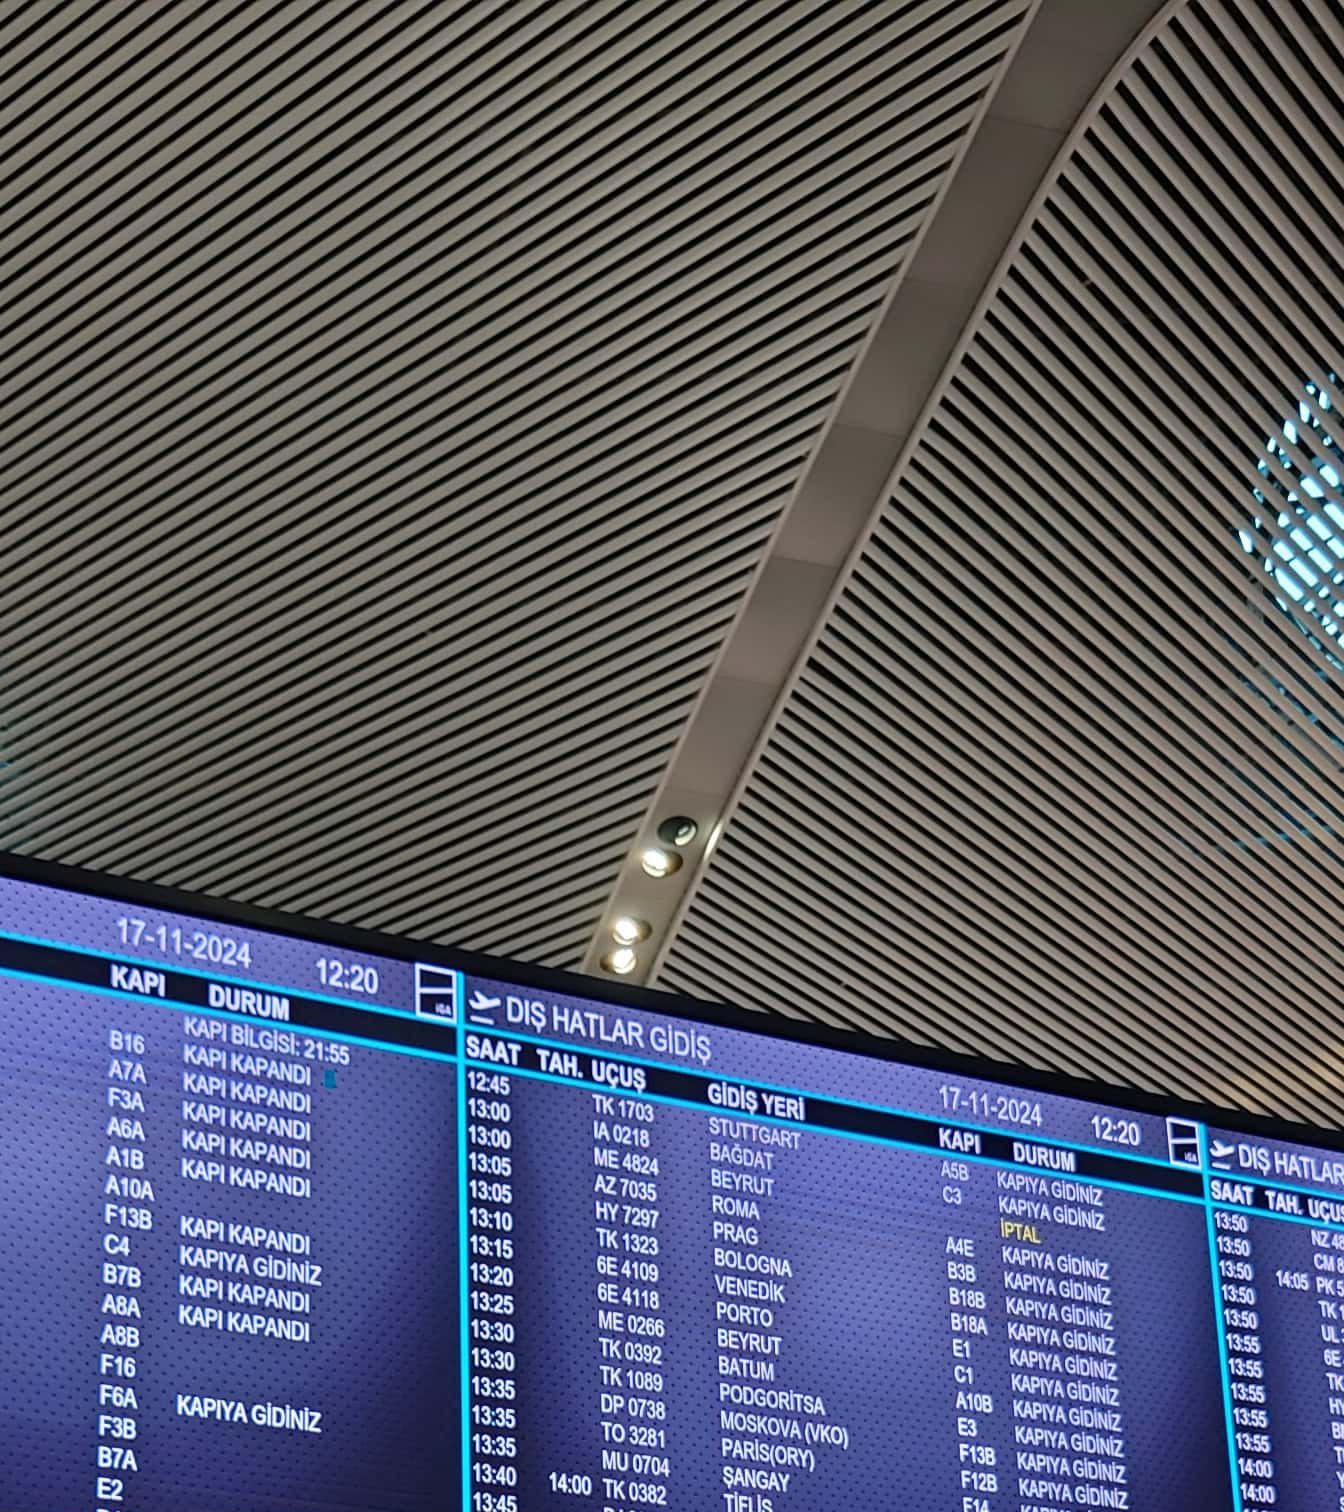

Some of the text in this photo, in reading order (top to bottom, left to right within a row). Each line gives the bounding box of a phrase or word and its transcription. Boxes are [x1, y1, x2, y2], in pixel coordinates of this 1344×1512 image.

[117, 917, 251, 968] 17-11-2024
[316, 958, 378, 994] 12:20
[111, 964, 165, 996] KAPI
[209, 983, 289, 1020] DURUM
[184, 1016, 226, 1041] KAPI
[231, 1023, 300, 1055] BİLGİSİ:
[303, 1038, 349, 1065] 21:55
[506, 995, 1140, 1146] DIŞ HATLAR GİDİŞ 17-11-2024 12:20
[108, 1086, 144, 1112] F3A
[182, 1100, 225, 1126] KAPI
[229, 1109, 310, 1141] KAPANDI
[466, 1034, 1075, 1172] SAAT TAH. UÇUŞ GİDİŞ YERİ KAPI DURUM
[468, 1124, 1041, 1243] 13:00 ME 4824 BEYRUT İPTAL
[1238, 1143, 1270, 1176] DIŞ
[1210, 1179, 1253, 1205] SAAT
[1264, 1189, 1302, 1214] TAH.
[1218, 1259, 1252, 1280] 13:50
[1275, 1269, 1309, 1290] 14:05
[99, 1383, 137, 1408] F6A
[177, 1394, 248, 1423] KAPIYA
[251, 1401, 321, 1433] GİDİNİZ
[471, 1375, 1126, 1484] 13:35 DP 0738 MOSKOVA (VKO) F13B KAPIYA GİDİNİZ
[472, 1462, 516, 1486] 13:40
[549, 1471, 591, 1495] 14:00
[602, 1477, 625, 1499] TK
[628, 1481, 666, 1505] 0382
